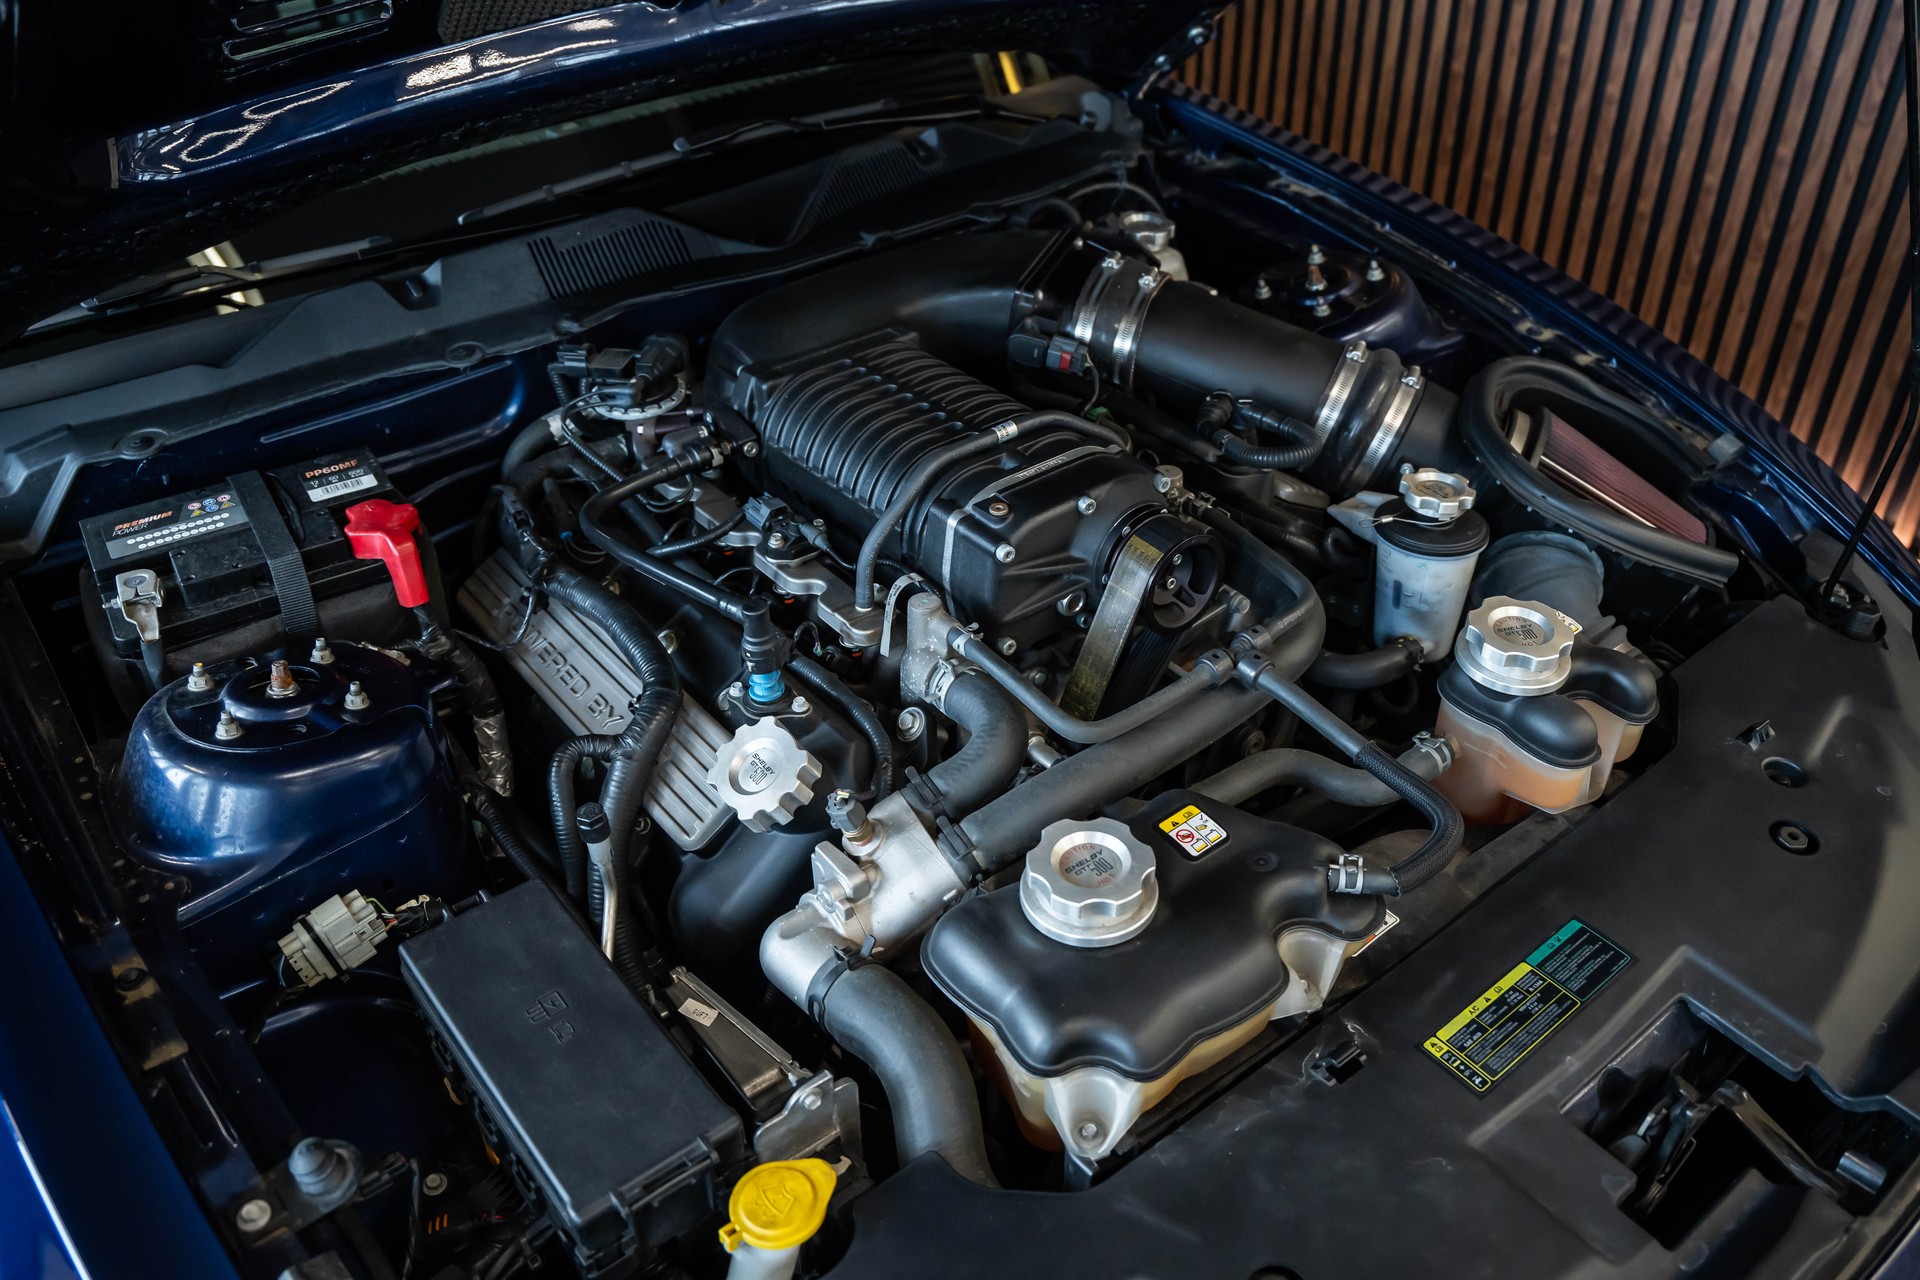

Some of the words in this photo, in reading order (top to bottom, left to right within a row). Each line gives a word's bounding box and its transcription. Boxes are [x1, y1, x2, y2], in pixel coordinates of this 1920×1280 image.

[304, 459, 358, 479] PP60MF
[114, 510, 173, 531] PREMIUM
[112, 523, 149, 537] POWER
[1495, 616, 1528, 627] CAUTION
[1497, 623, 1533, 633] SHELBY
[586, 692, 624, 731] BY
[751, 752, 776, 776] SHELBY
[1065, 849, 1104, 874] SHELBY
[1097, 873, 1116, 887] HOT
[1468, 1005, 1479, 1016] A/C
